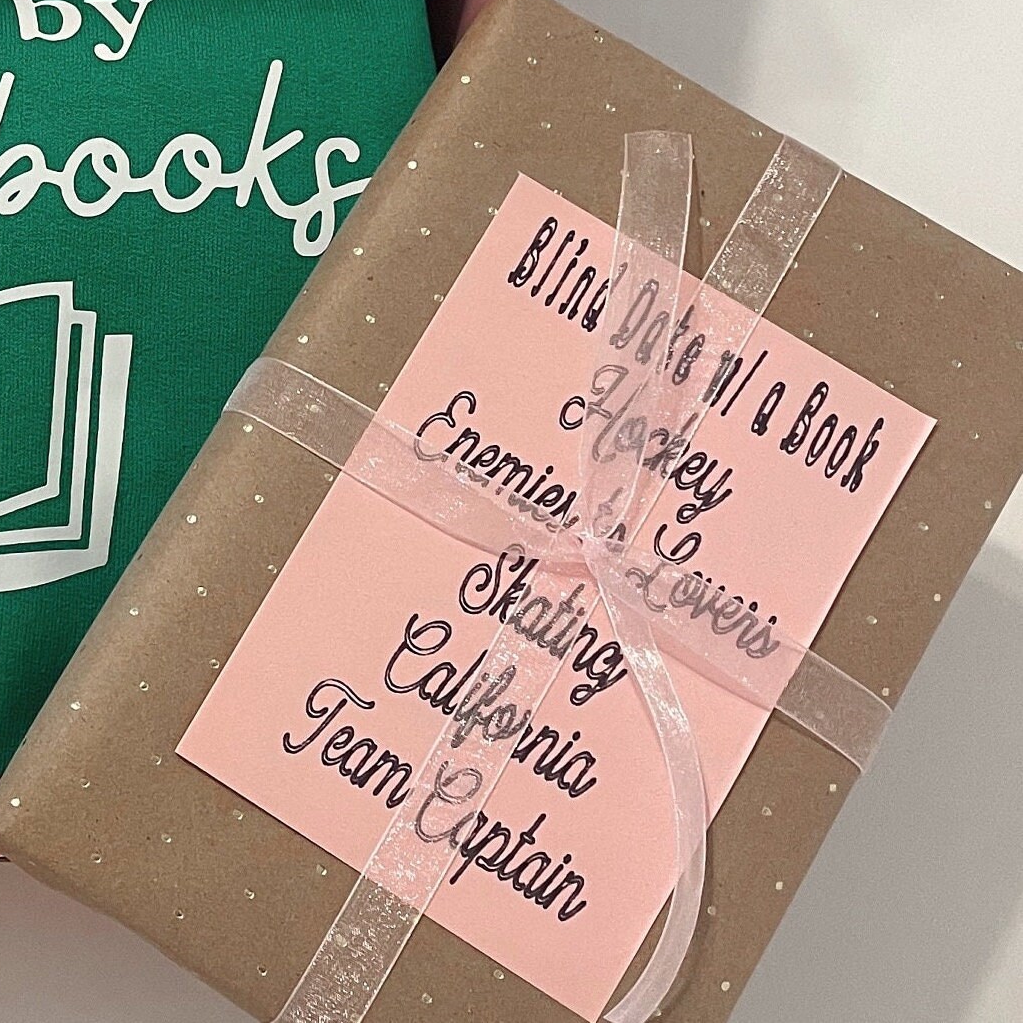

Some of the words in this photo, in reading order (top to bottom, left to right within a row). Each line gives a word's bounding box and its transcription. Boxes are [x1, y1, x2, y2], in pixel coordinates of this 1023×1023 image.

[507, 216, 628, 333] Blind
[609, 277, 706, 387] Date
[750, 380, 786, 437] a
[779, 380, 885, 494] Book
[558, 363, 734, 525] Hockey
[413, 389, 580, 534] Enemies
[624, 522, 781, 659] Lovers
[458, 542, 629, 707] Skating
[282, 677, 413, 809] Team
[413, 760, 588, 922] Captain
[383, 612, 598, 799] California
